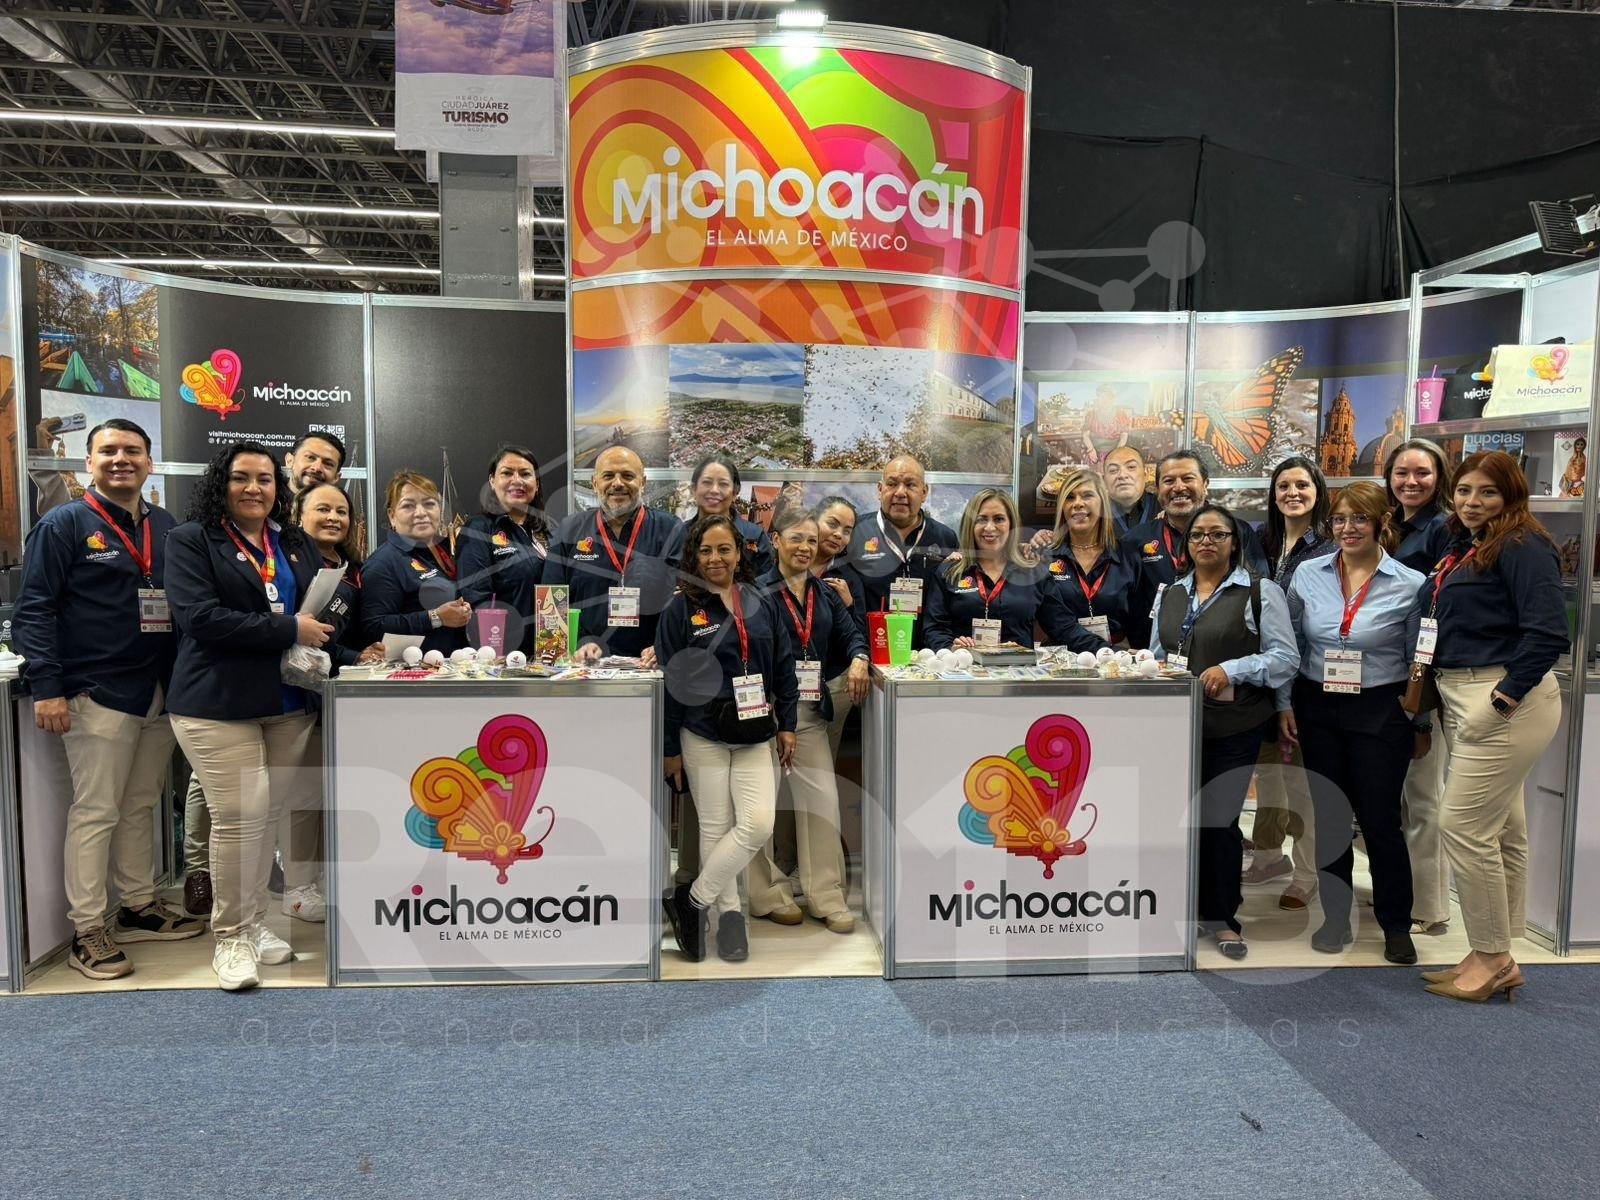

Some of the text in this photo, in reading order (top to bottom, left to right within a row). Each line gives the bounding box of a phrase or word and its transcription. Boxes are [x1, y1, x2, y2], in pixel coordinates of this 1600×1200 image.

[442, 111, 509, 124] TURISMO
[612, 142, 985, 239] Michoacán
[706, 227, 908, 252] EL ALMA DE MÉXICO
[253, 382, 352, 403] Michoacán
[1516, 385, 1582, 397] Michoacán
[208, 431, 296, 440] visitmichoacan.com.mx
[374, 884, 619, 933] Michoacán
[928, 879, 1157, 928] Michoacán
[439, 927, 562, 941] EL ALMA DE MÉXICO
[989, 921, 1104, 935] EL ALMA DE MÉXICO
